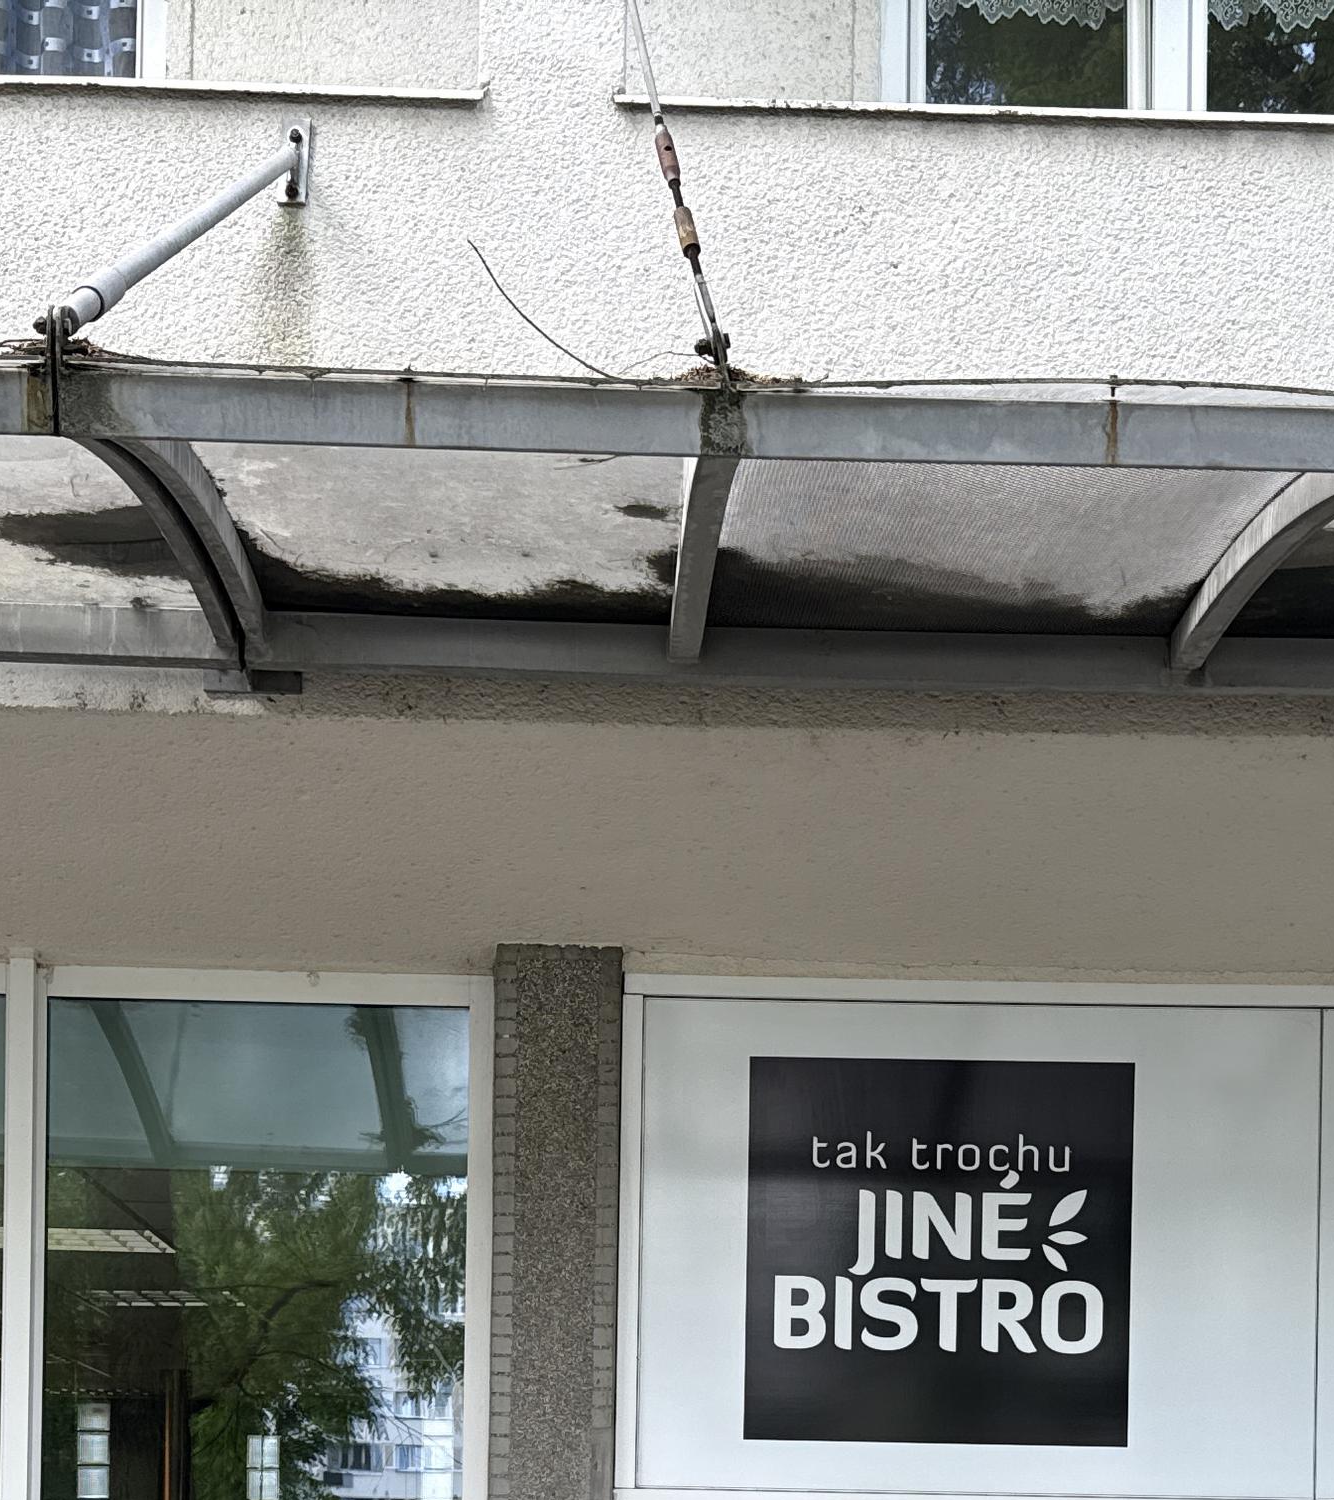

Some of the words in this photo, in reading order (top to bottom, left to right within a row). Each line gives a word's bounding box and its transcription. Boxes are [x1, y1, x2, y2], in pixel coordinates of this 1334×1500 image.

[812, 1130, 887, 1169] tak
[912, 1133, 1071, 1173] trochu
[848, 1170, 1032, 1276] JINÉ
[774, 1275, 1104, 1354] BISTRO
